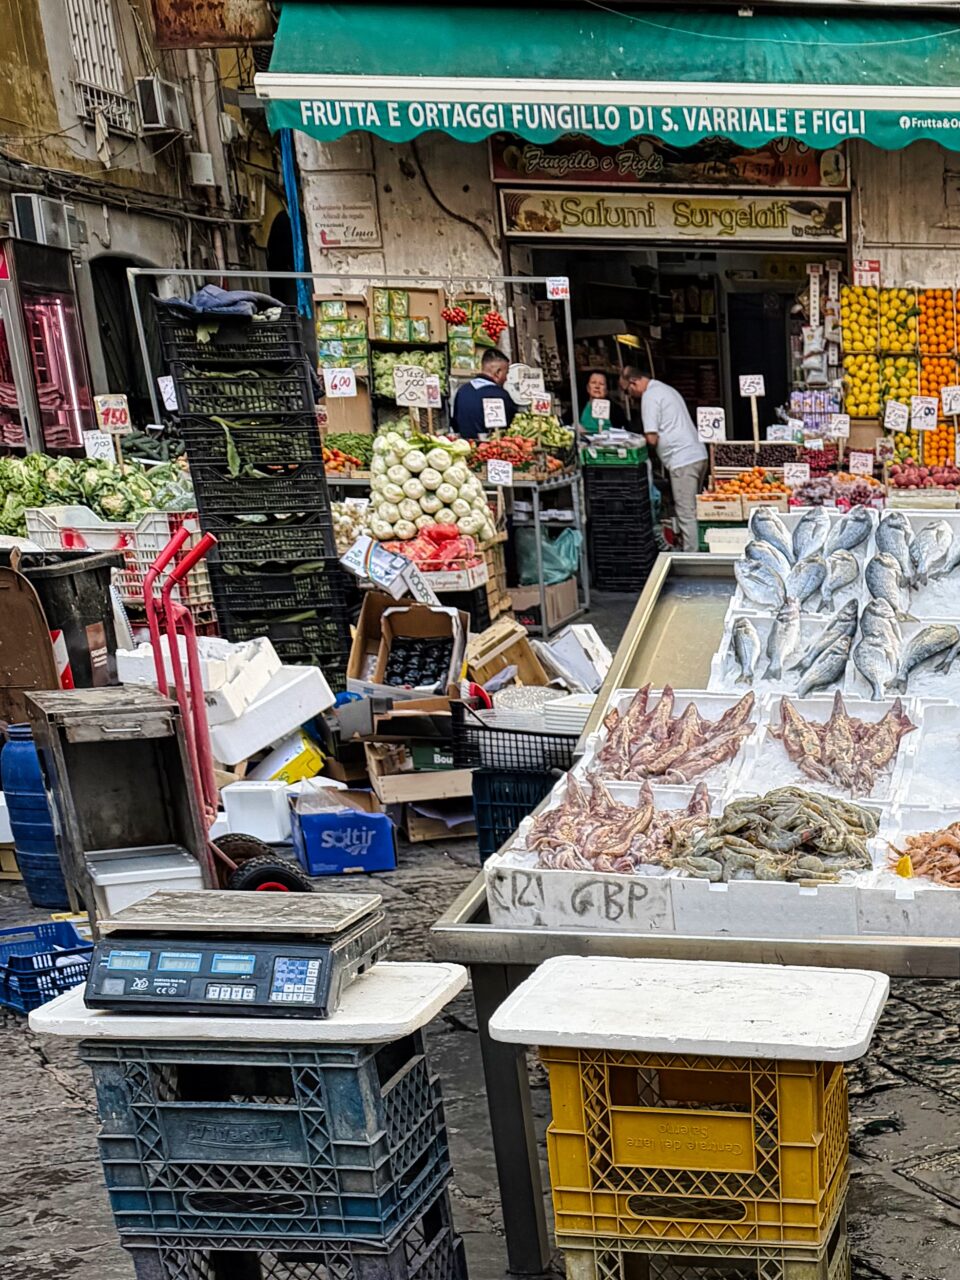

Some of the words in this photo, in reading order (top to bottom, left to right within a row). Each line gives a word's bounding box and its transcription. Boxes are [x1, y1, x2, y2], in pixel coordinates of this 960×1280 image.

[300, 101, 381, 127] FRUTTA
[388, 102, 401, 127] E
[407, 102, 505, 129] ORTAGGI
[512, 103, 620, 131] FUNGILLO
[629, 106, 653, 131] DI
[662, 107, 679, 132] S.
[682, 107, 787, 133] VARRIALE
[795, 111, 806, 134] E
[812, 110, 865, 134] FIGLI
[524, 149, 598, 175] Fungillo
[603, 157, 613, 171] e
[617, 150, 662, 177] Figli
[560, 198, 657, 229] Salumi
[673, 199, 790, 235] Surgelati
